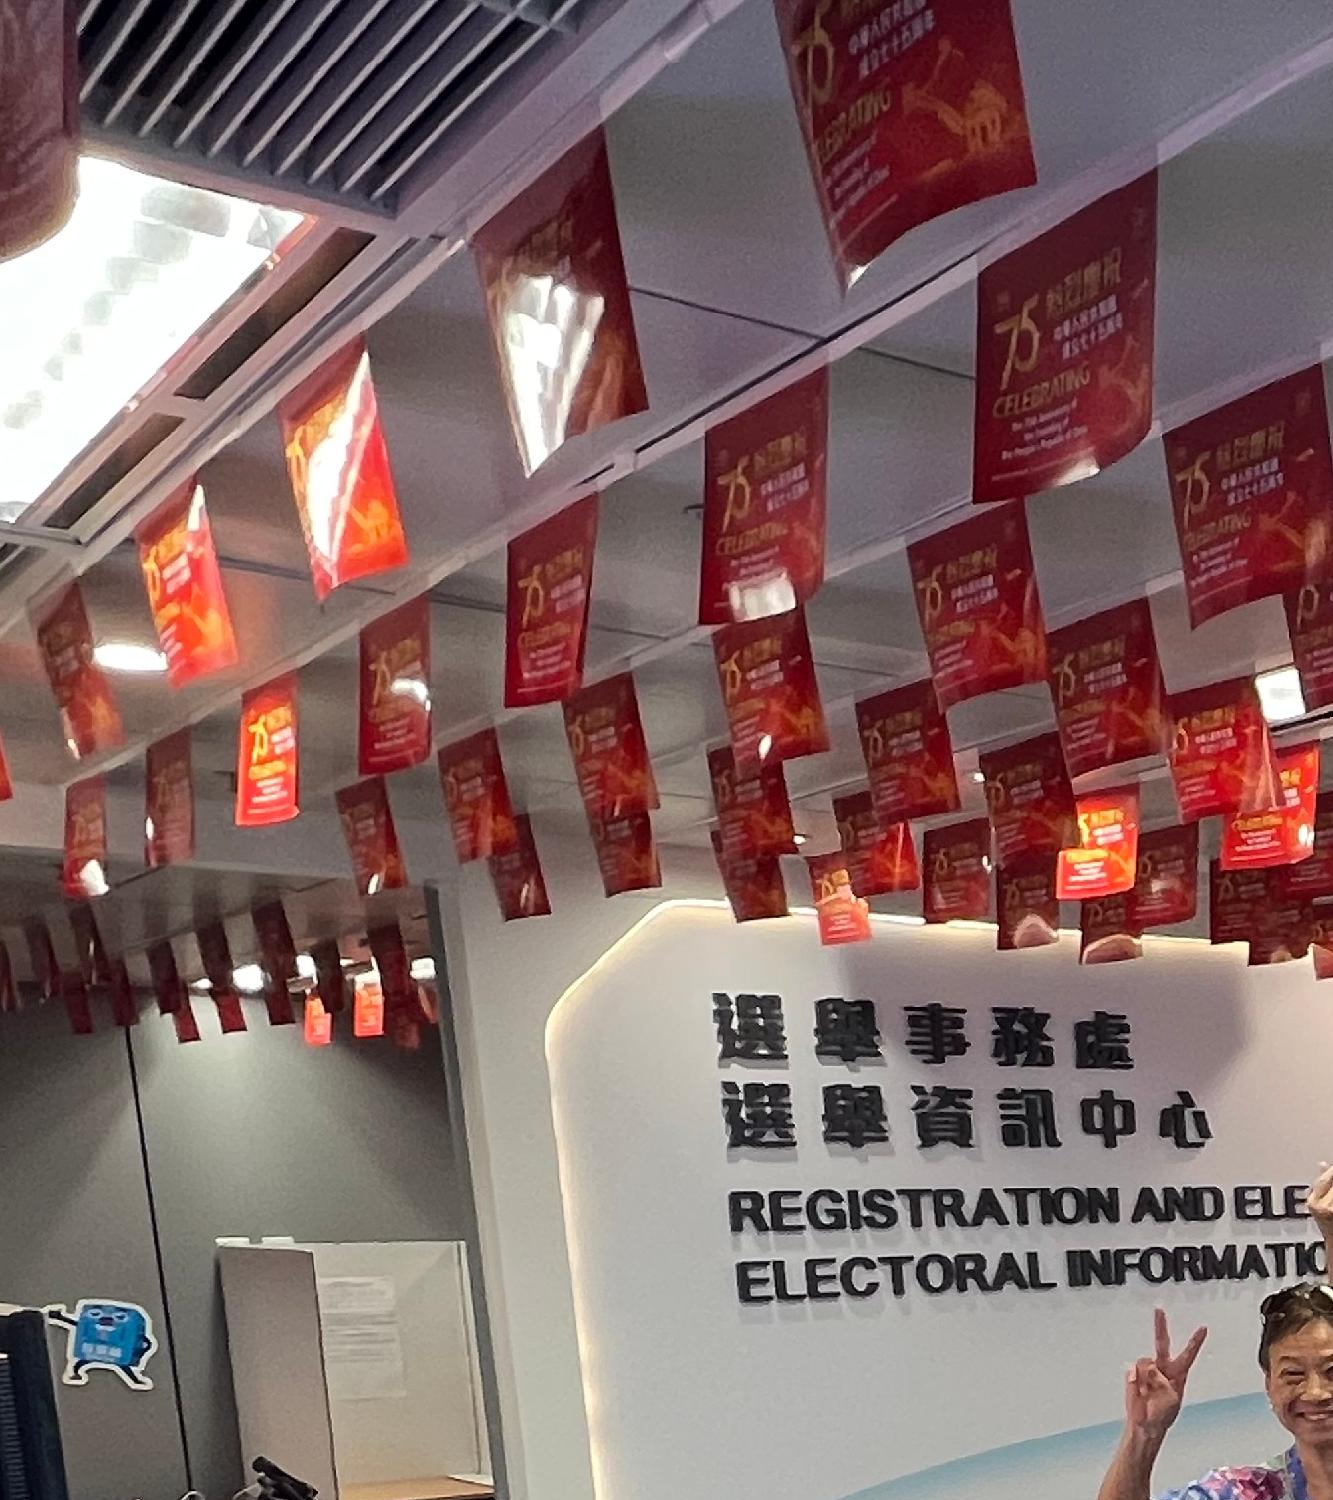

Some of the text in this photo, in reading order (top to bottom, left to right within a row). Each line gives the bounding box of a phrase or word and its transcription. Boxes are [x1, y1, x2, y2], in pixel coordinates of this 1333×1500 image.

[993, 293, 1040, 391] 75
[992, 361, 1092, 418] CELEBRATING
[712, 993, 1135, 1070] 選舉事務處
[721, 1081, 1215, 1149] 選舉資訊中心
[729, 1188, 1120, 1232] REGISTRATION
[1132, 1187, 1223, 1226] AND
[735, 1252, 1056, 1304] ELECTORAL
